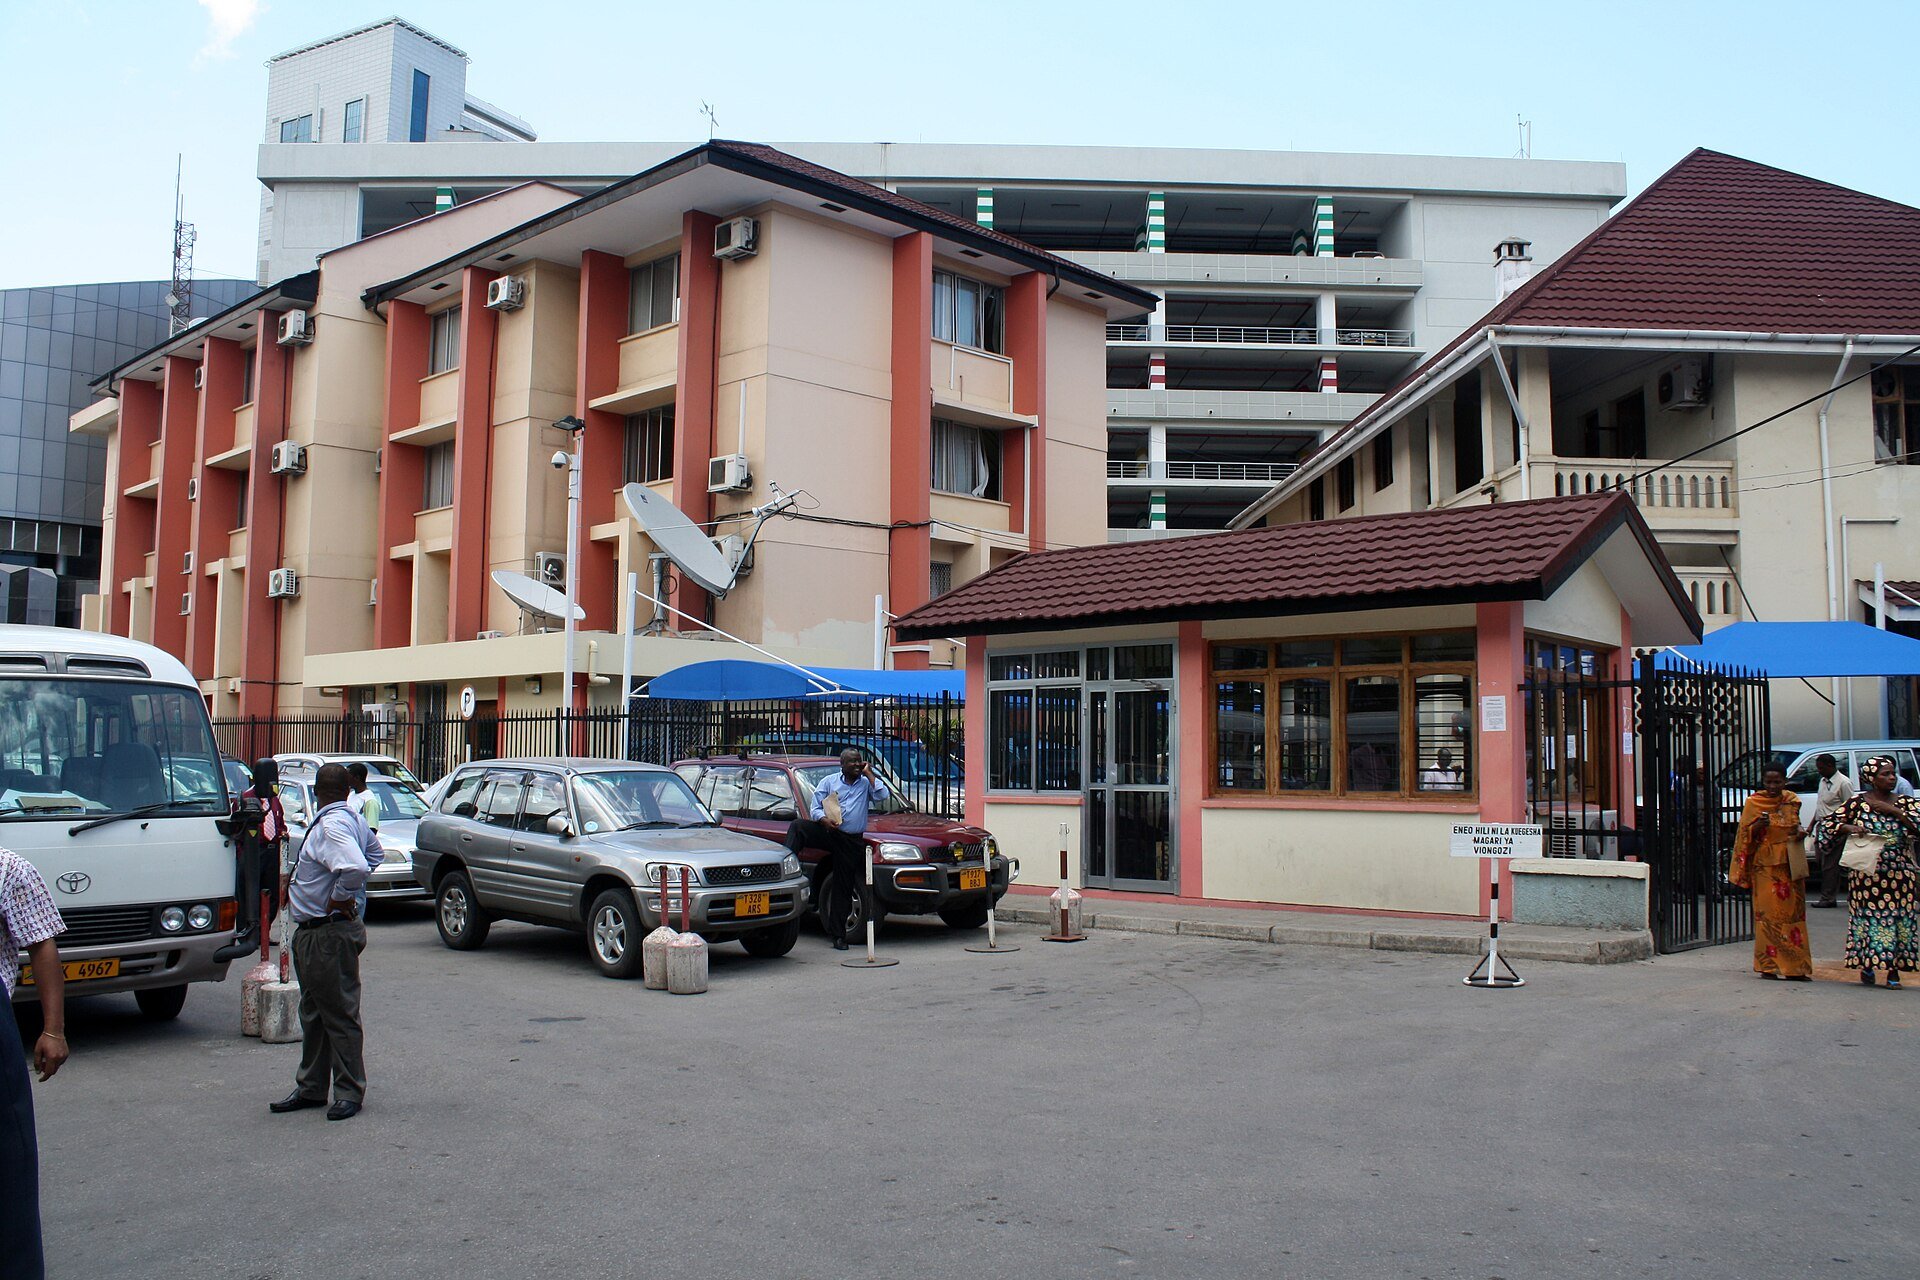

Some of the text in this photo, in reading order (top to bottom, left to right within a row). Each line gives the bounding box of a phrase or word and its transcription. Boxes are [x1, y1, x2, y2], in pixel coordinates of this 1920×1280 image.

[464, 692, 471, 712] P
[1453, 826, 1542, 836] ENEO HILI NI LA KUEGESHA
[1473, 836, 1514, 845] MAGARI YA
[1474, 846, 1512, 854] VIONGOZI
[747, 904, 762, 914] ARS
[78, 962, 113, 978] 4967
